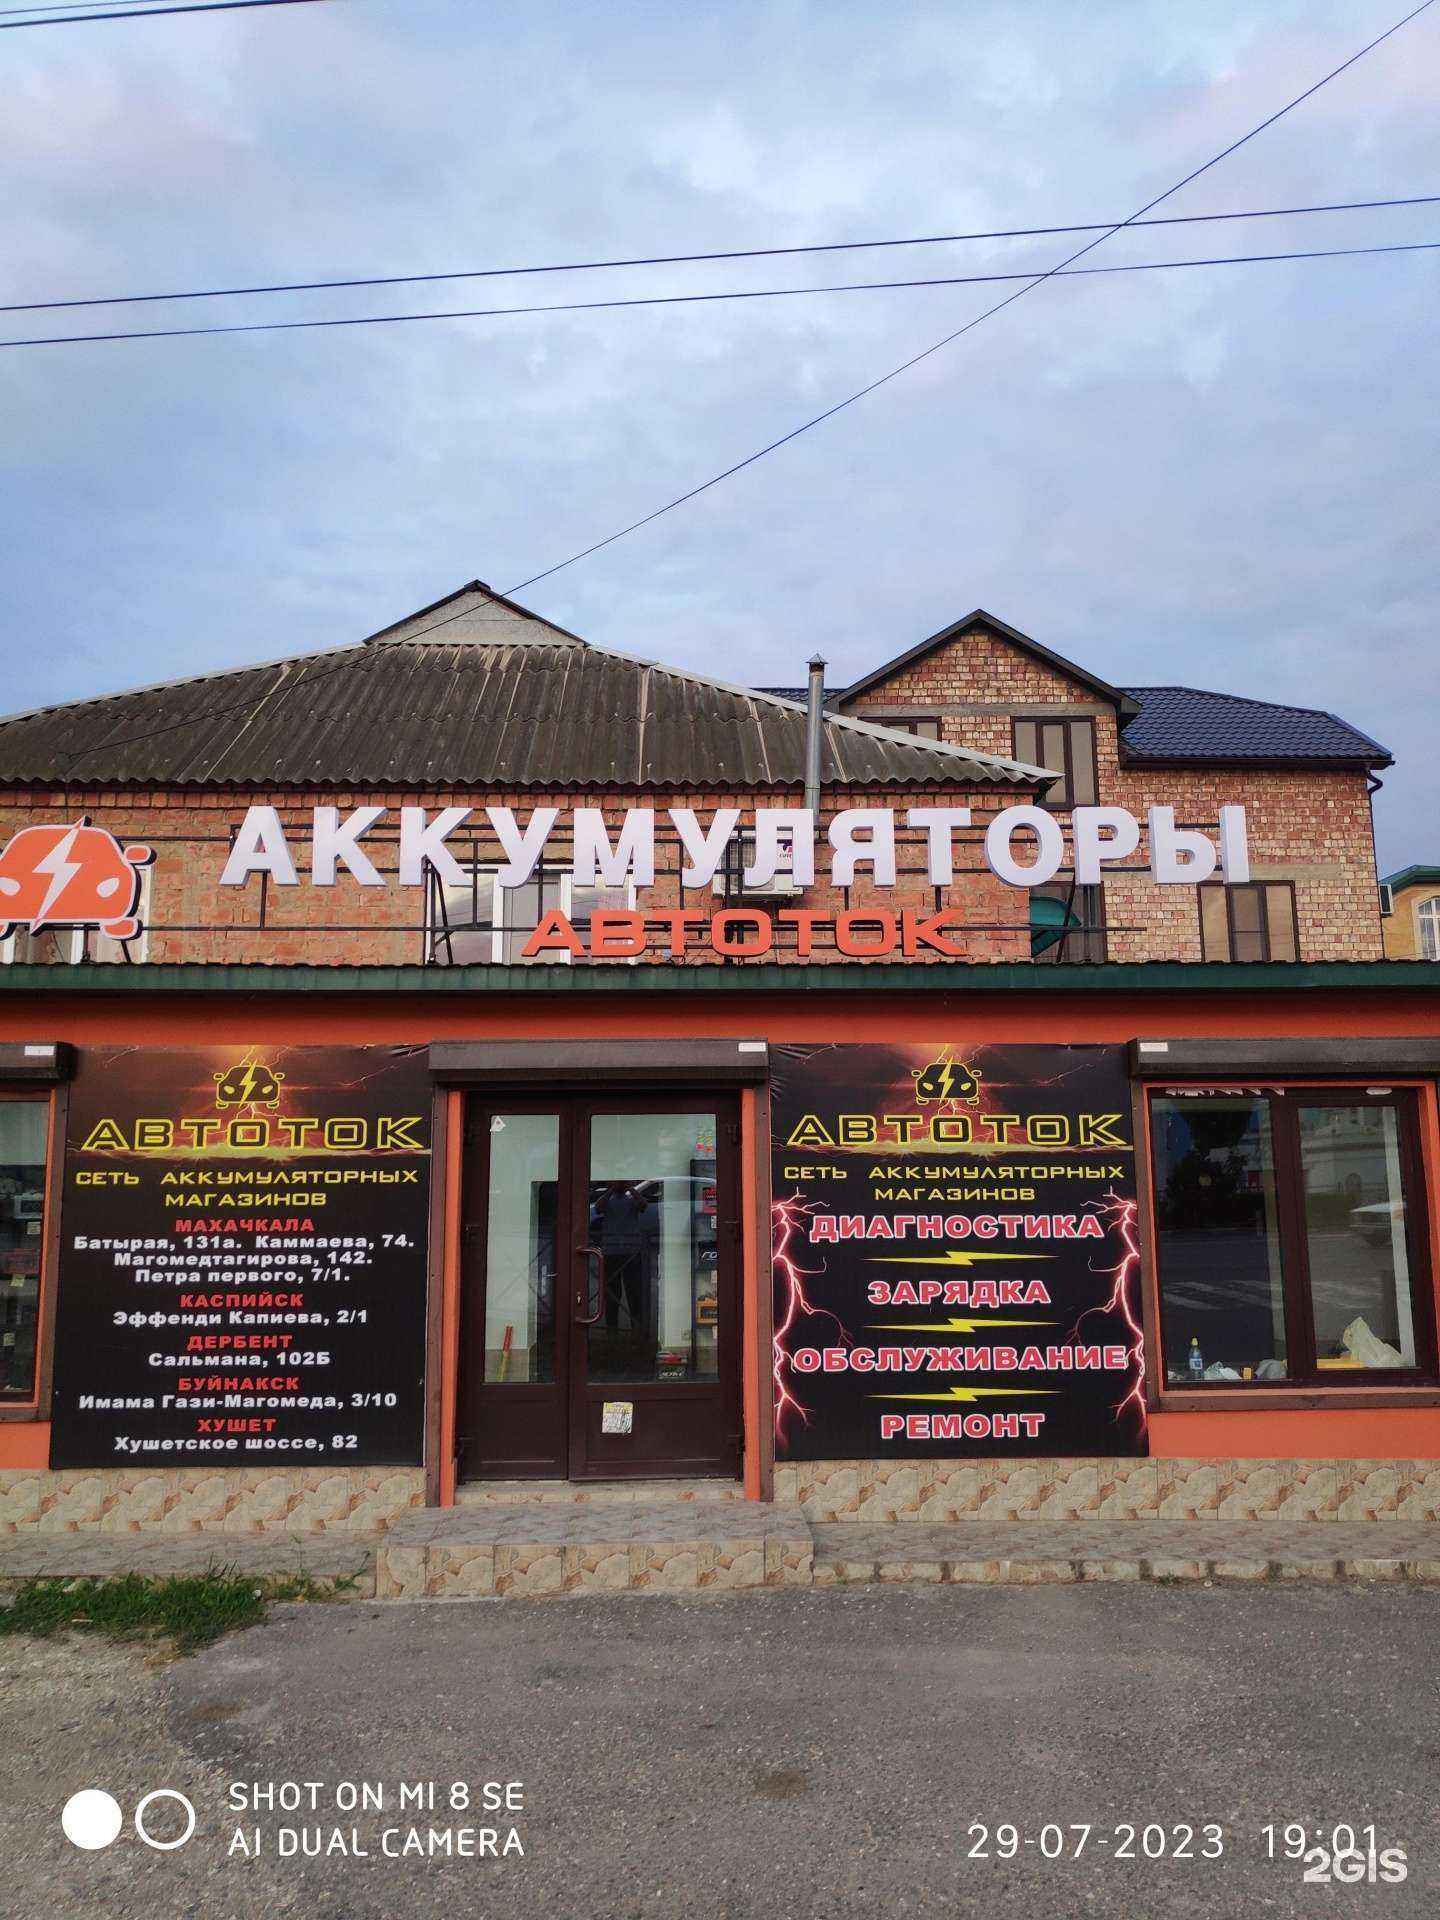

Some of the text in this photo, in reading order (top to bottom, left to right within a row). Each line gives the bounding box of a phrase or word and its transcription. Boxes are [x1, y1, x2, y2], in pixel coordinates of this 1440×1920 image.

[219, 803, 1251, 889] АККУМУЛЯТОРЫ
[521, 908, 970, 958] АВТОТОК
[81, 1117, 424, 1150] АВТОТОК
[786, 1114, 1127, 1147] АВТОТОК
[75, 1170, 419, 1185] СЕТЬ АККУМУЛЯТОРНЫХ
[783, 1165, 1125, 1179] СЕТЬ АККУМУЛЯТОРНЫХ
[165, 1192, 327, 1206] МАГАЗИНОВ
[874, 1188, 1036, 1201] МАГАЗИНОВ
[174, 1218, 315, 1232] МАХАЧКАЛА
[809, 1215, 1105, 1243] ДИАГНОСТИКА
[73, 1234, 415, 1251] Батырая, 131а. Каммаева, 74.
[114, 1251, 373, 1268] Магомедтагирова, 142.
[135, 1268, 350, 1285] Петра первого, 7/1.
[180, 1291, 304, 1307] КАСПИЙСК
[867, 1280, 1052, 1309] ЗАРЯДКА
[113, 1309, 368, 1328] Эффенди Капиева, 2/1
[186, 1335, 293, 1350] ДЕРБЕНТ
[148, 1351, 331, 1369] Сальмана, 102Б
[792, 1346, 1128, 1373] ОБСЛУЖИВАНИЕ
[178, 1375, 300, 1391] БУЙНАКСК
[79, 1393, 398, 1410] Имама Гази-Магомеда, 3/10
[196, 1418, 277, 1433] ХУШЕТ
[880, 1413, 1046, 1439] РЕМОНТ
[114, 1435, 359, 1453] Хушетское шоссе, 82
